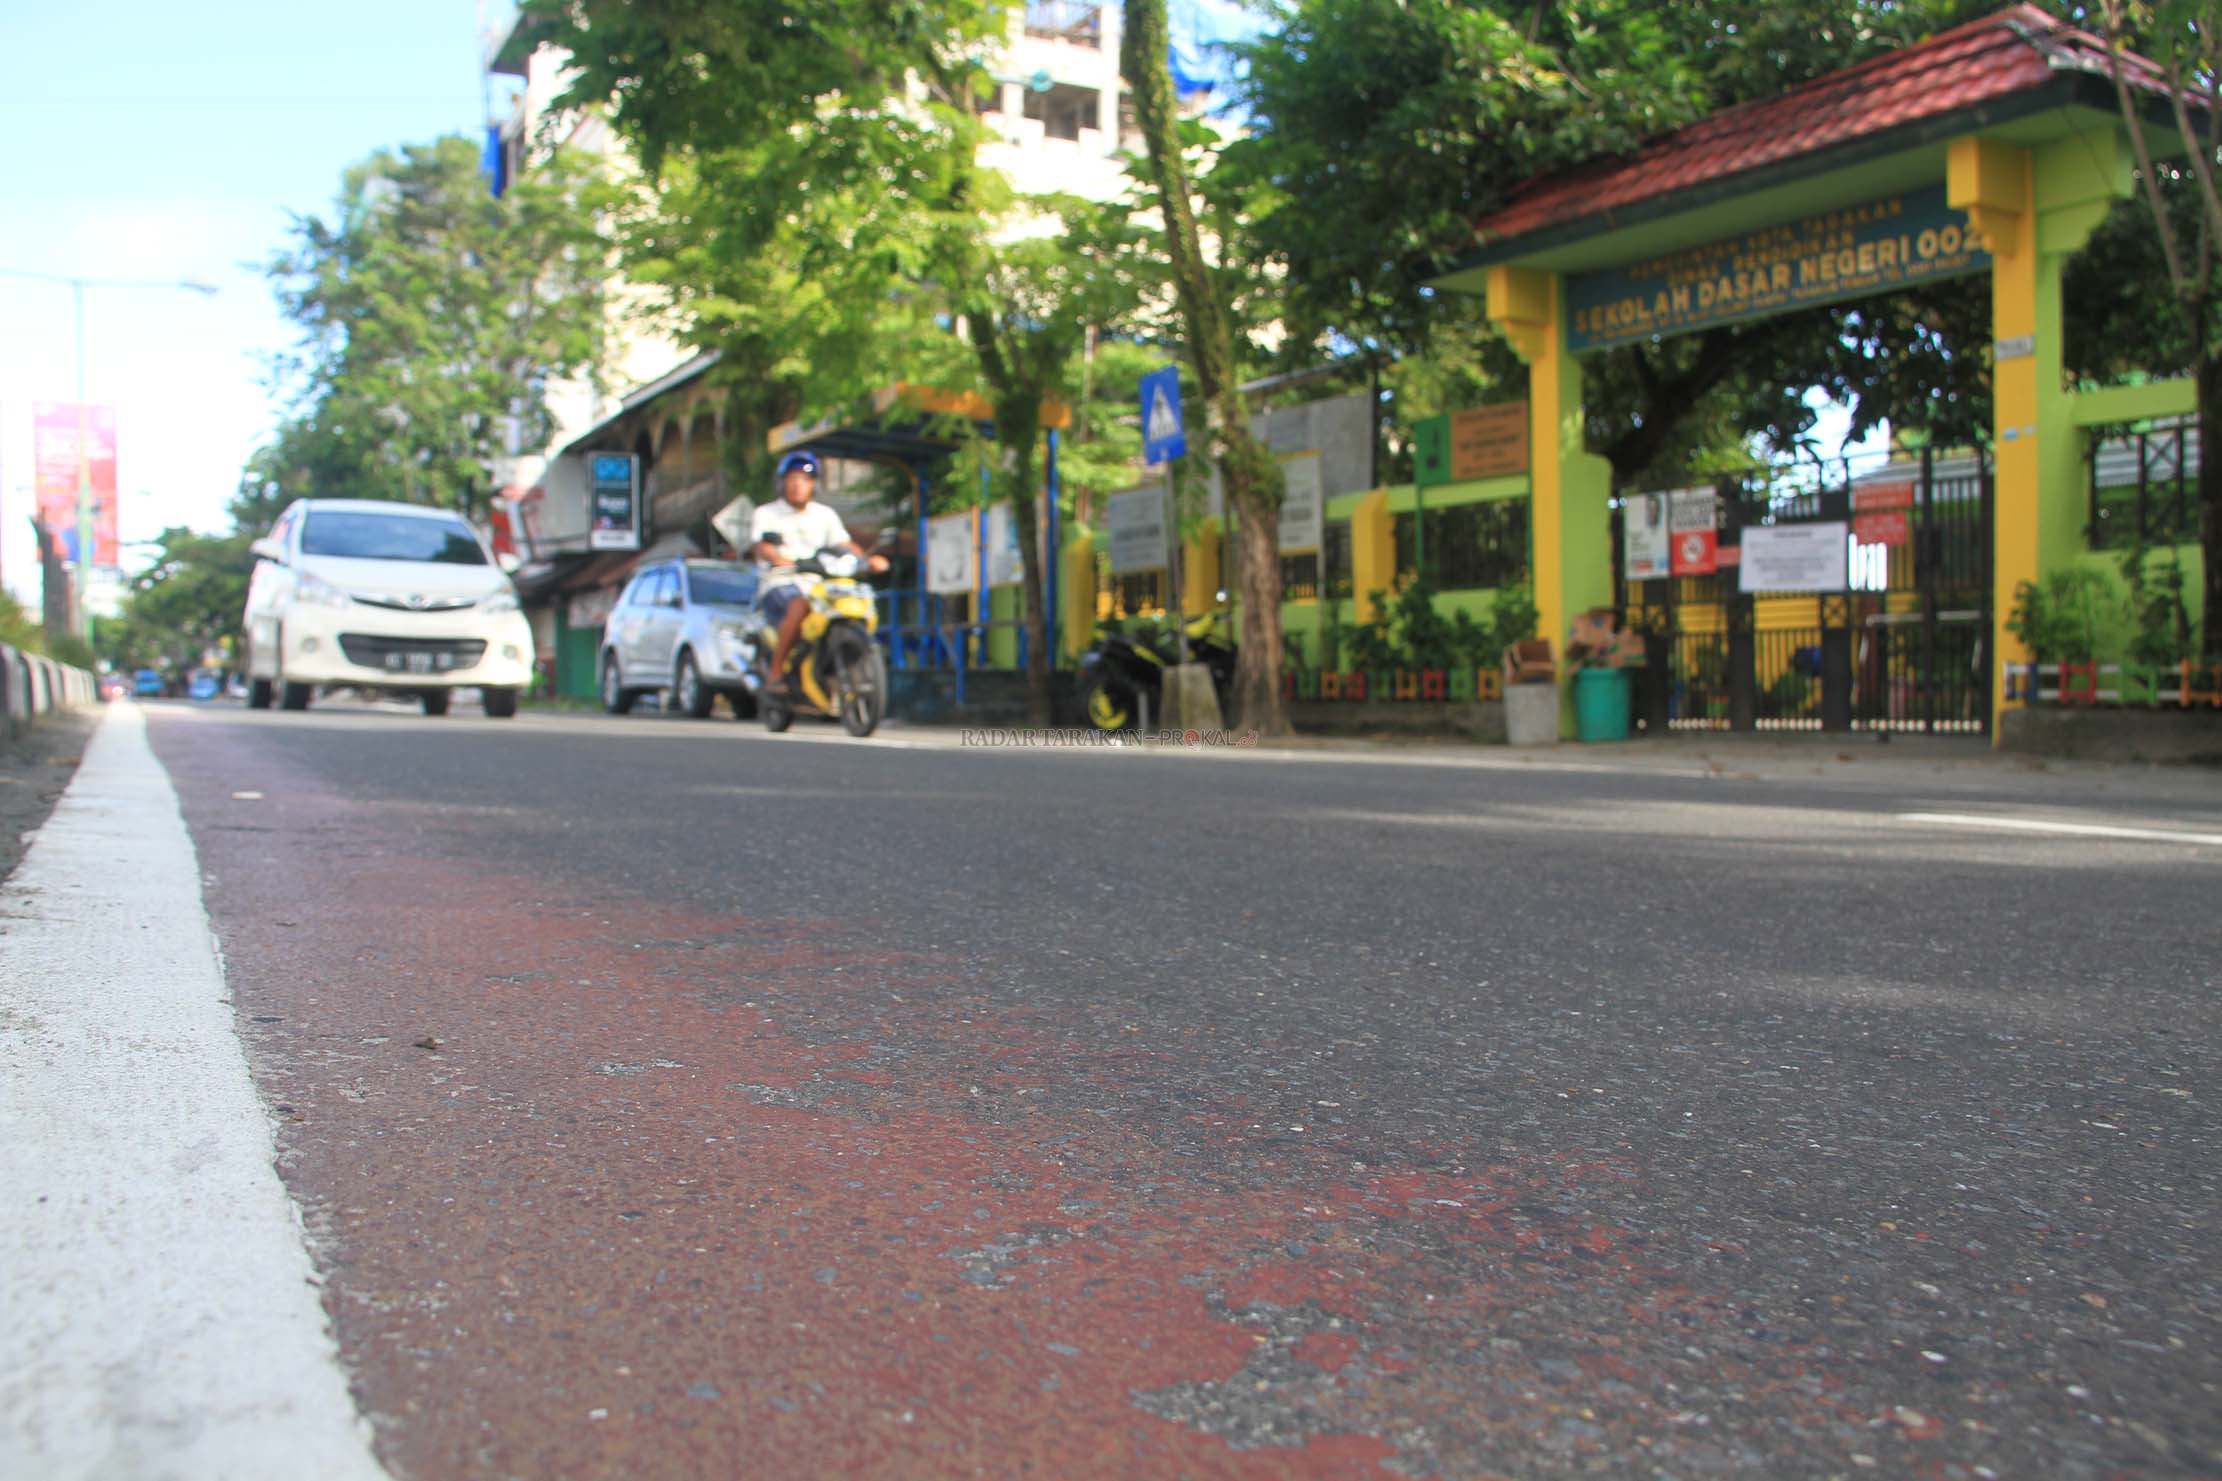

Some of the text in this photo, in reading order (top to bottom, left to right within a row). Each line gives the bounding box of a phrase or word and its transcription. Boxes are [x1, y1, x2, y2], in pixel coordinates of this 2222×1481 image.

[1575, 285, 1692, 335] SEKOLAH
[1698, 262, 1792, 308] DASAR
[1801, 234, 1910, 284] NEGERI
